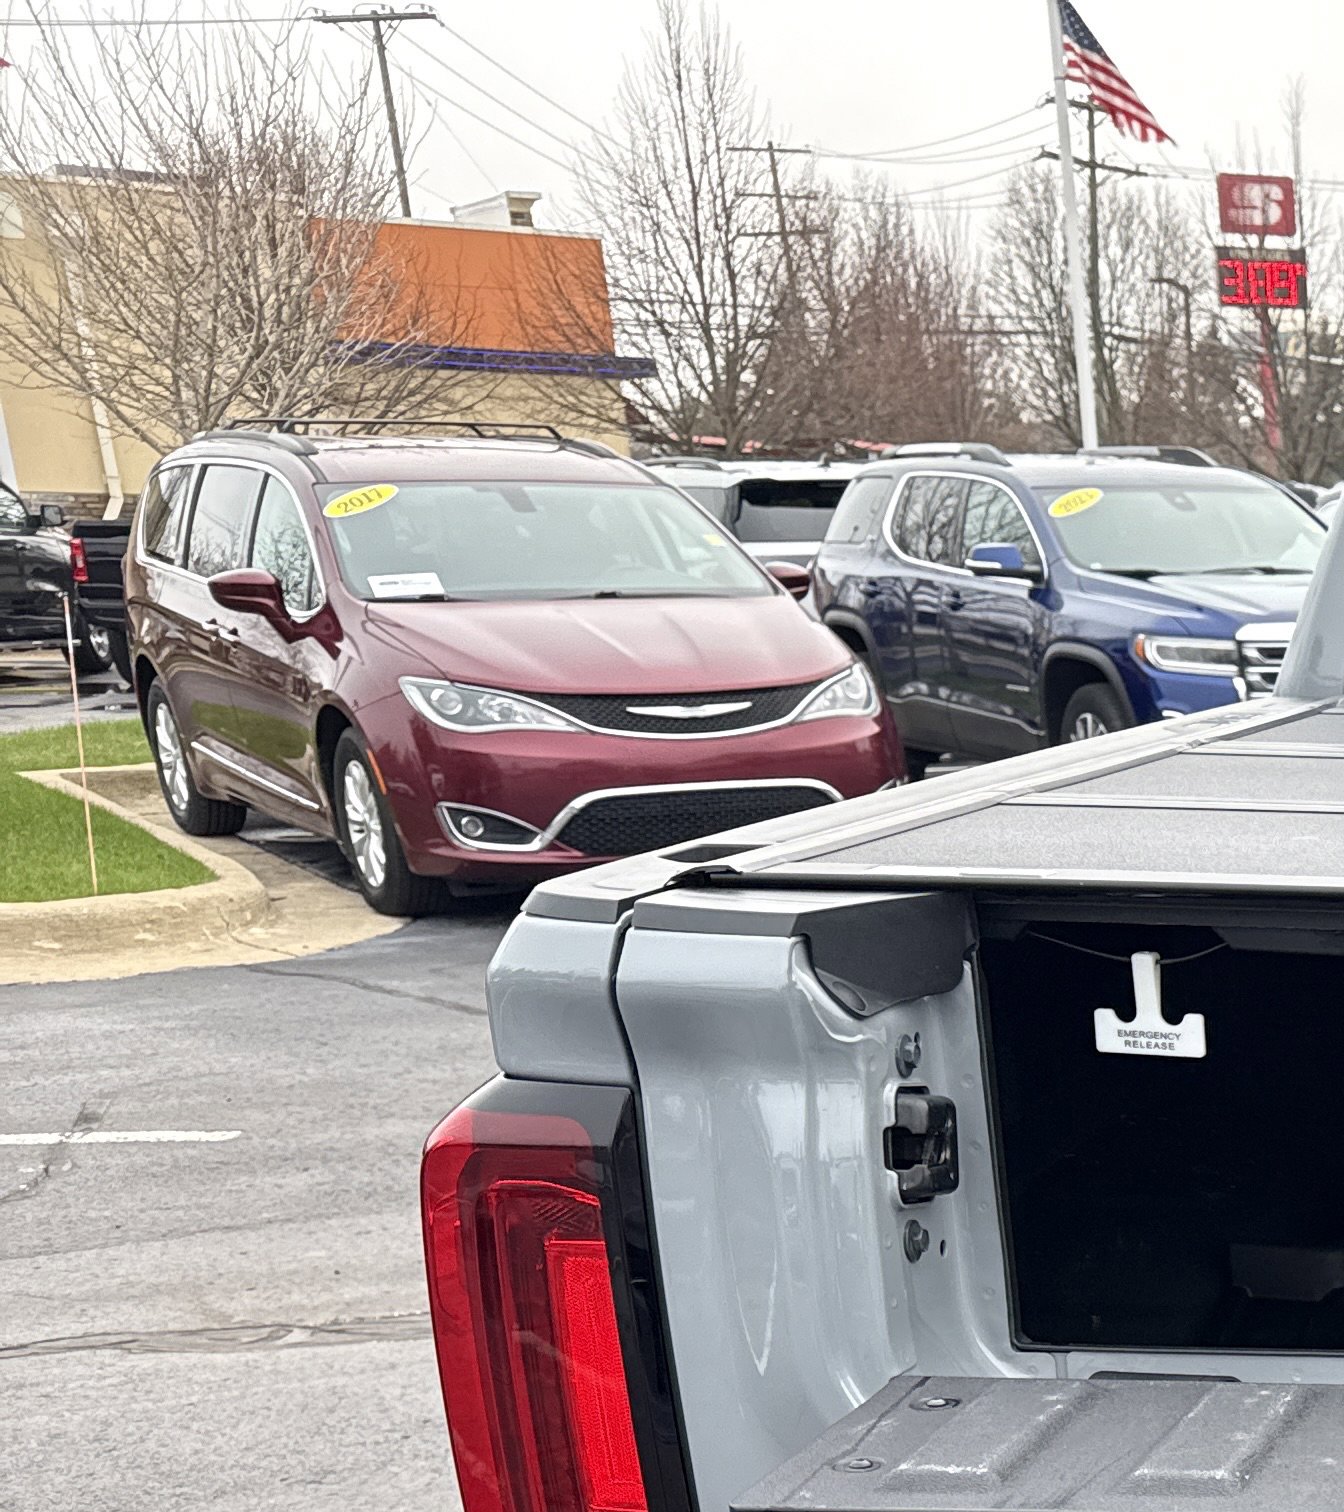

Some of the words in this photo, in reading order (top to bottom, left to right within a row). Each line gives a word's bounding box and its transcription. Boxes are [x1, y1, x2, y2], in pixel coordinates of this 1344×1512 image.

[336, 488, 383, 513] 2017
[1117, 1029, 1182, 1041] EMERGENCY
[1124, 1039, 1175, 1050] RELEASE
